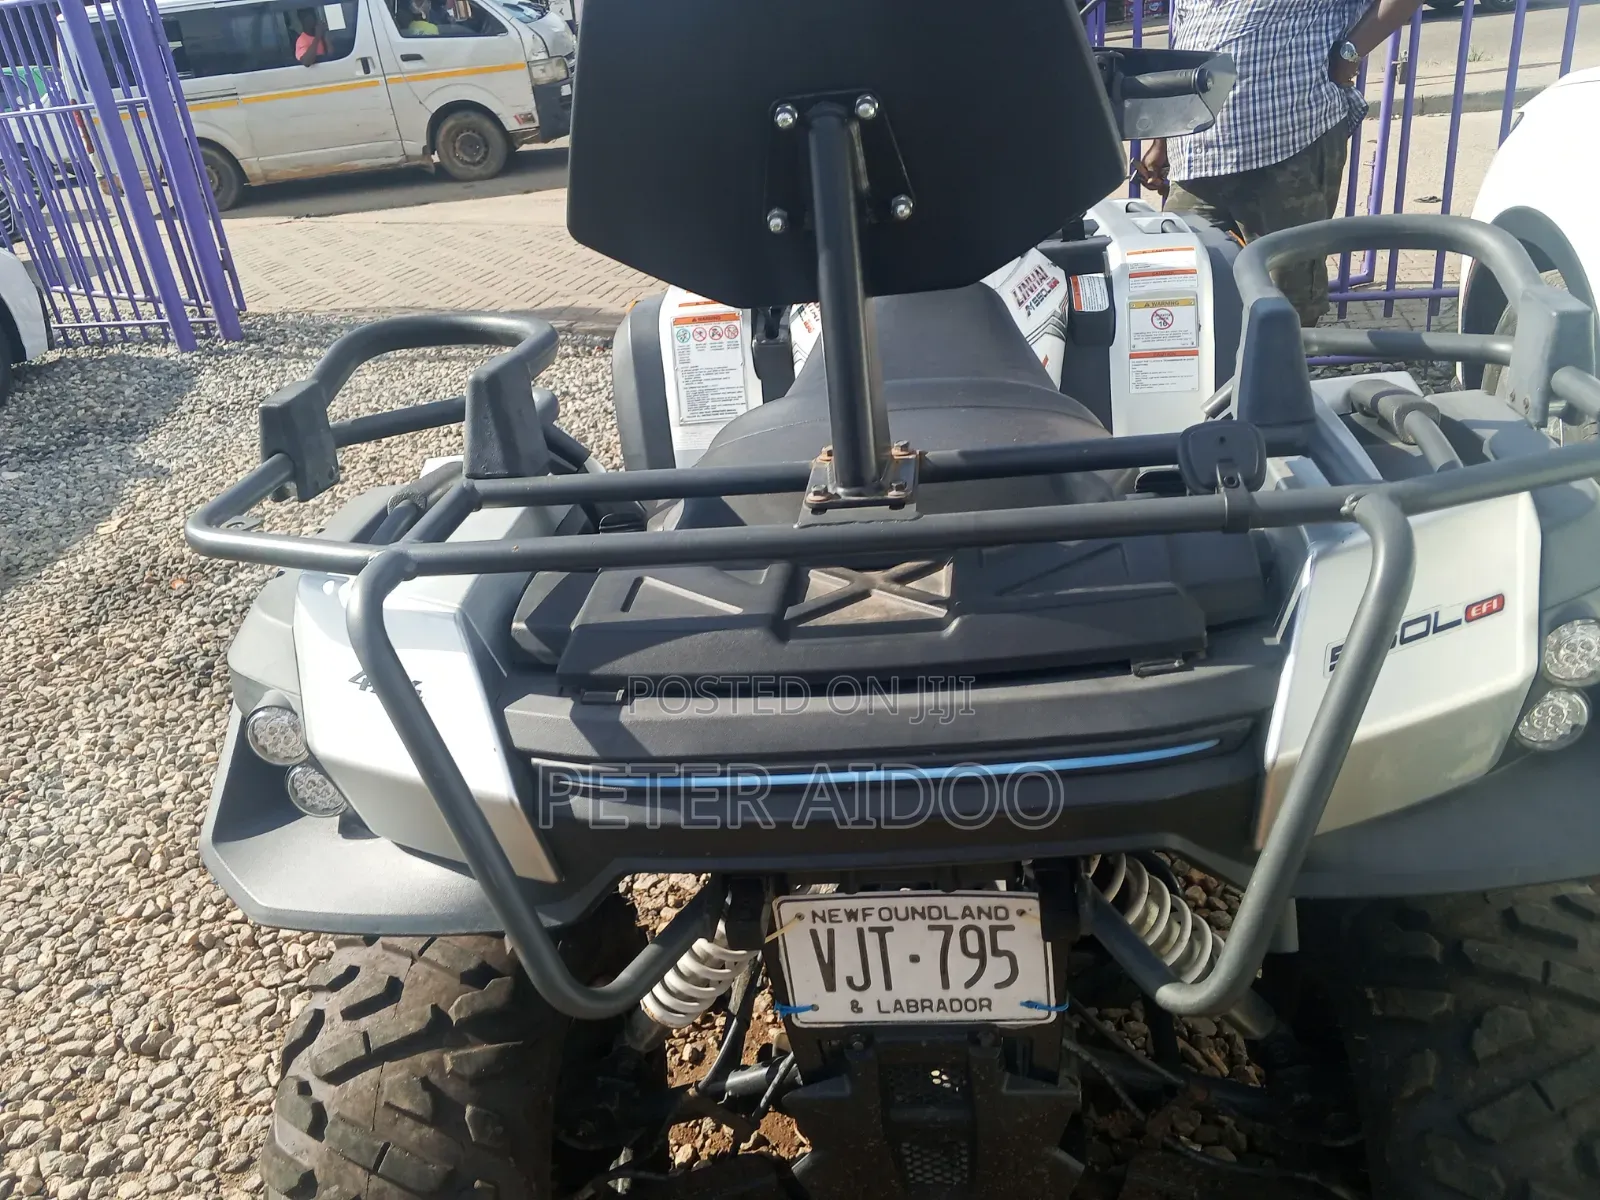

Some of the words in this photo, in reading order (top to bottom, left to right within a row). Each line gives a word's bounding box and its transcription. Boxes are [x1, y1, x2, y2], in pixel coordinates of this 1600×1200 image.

[1012, 264, 1050, 309] LINHAI
[1151, 300, 1180, 308] WARNING
[1470, 598, 1498, 617] EFI
[811, 905, 1010, 924] NEWFOUNDLAND
[850, 998, 863, 1014] &
[877, 997, 993, 1014] LABRADOR
